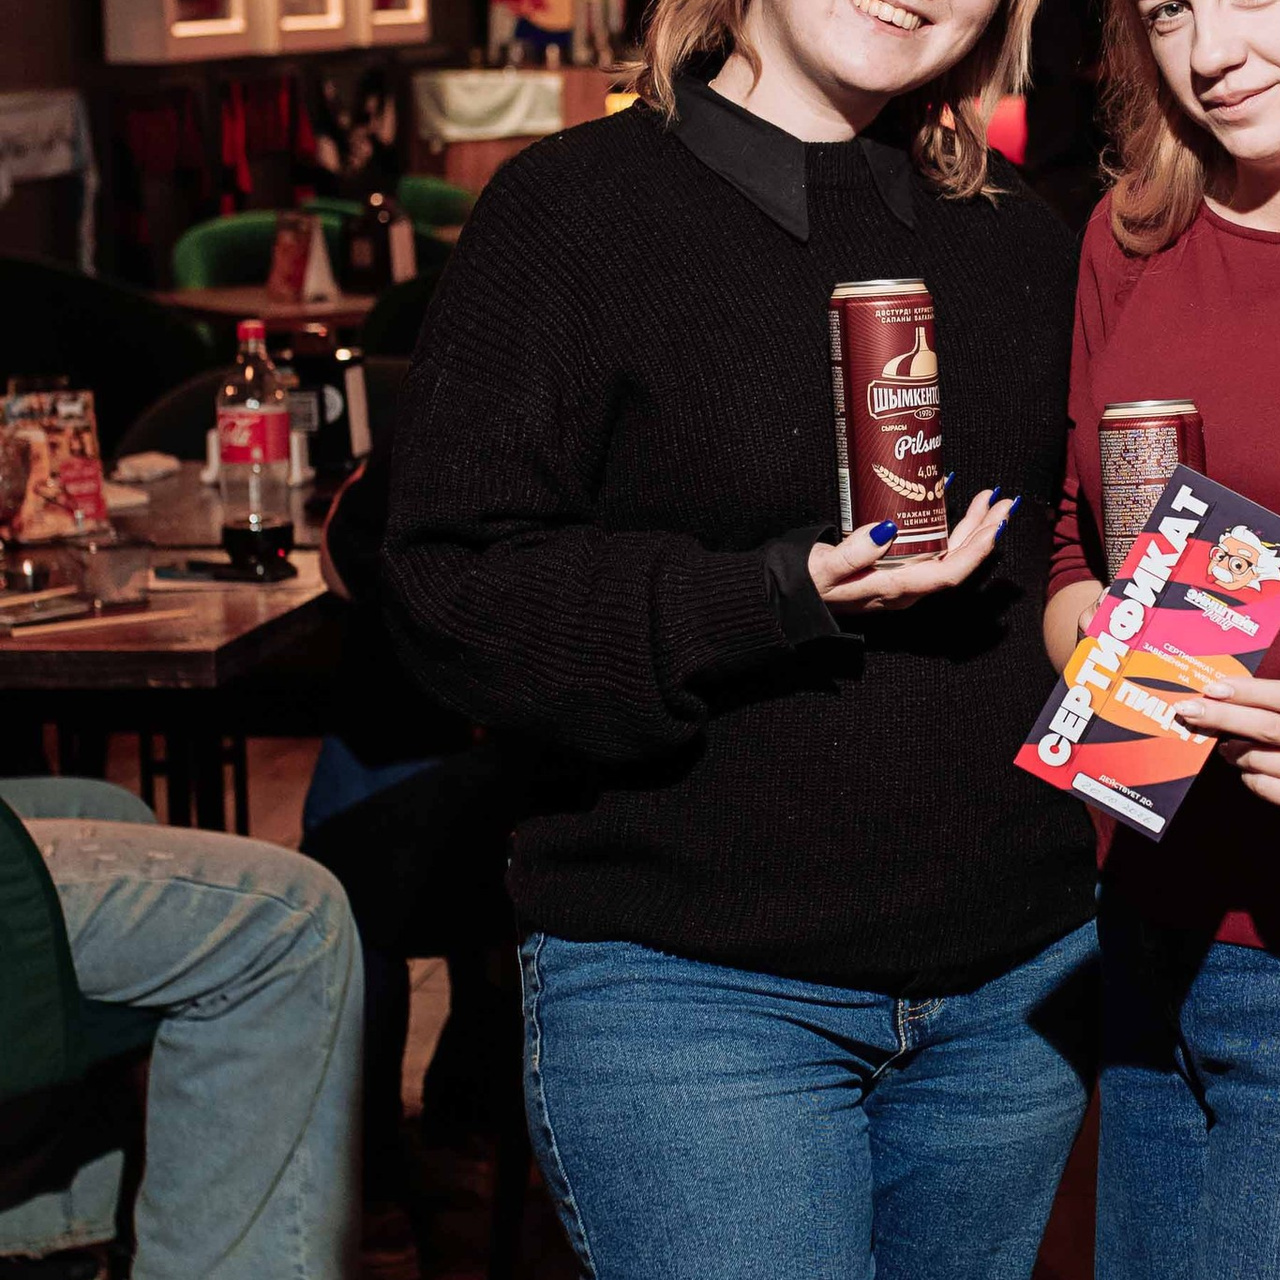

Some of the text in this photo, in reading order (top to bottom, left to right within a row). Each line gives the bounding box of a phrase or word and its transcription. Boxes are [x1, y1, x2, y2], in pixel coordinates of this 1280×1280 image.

[917, 464, 938, 479] 4,0%
[1038, 484, 1209, 767] СЕРТИФИКАТ
[1163, 642, 1215, 674] СЕРТИФИКАТ
[1115, 681, 1208, 744] ПИЦ
[1099, 774, 1154, 808] ДЕЙСТВУЕТ ДО:
